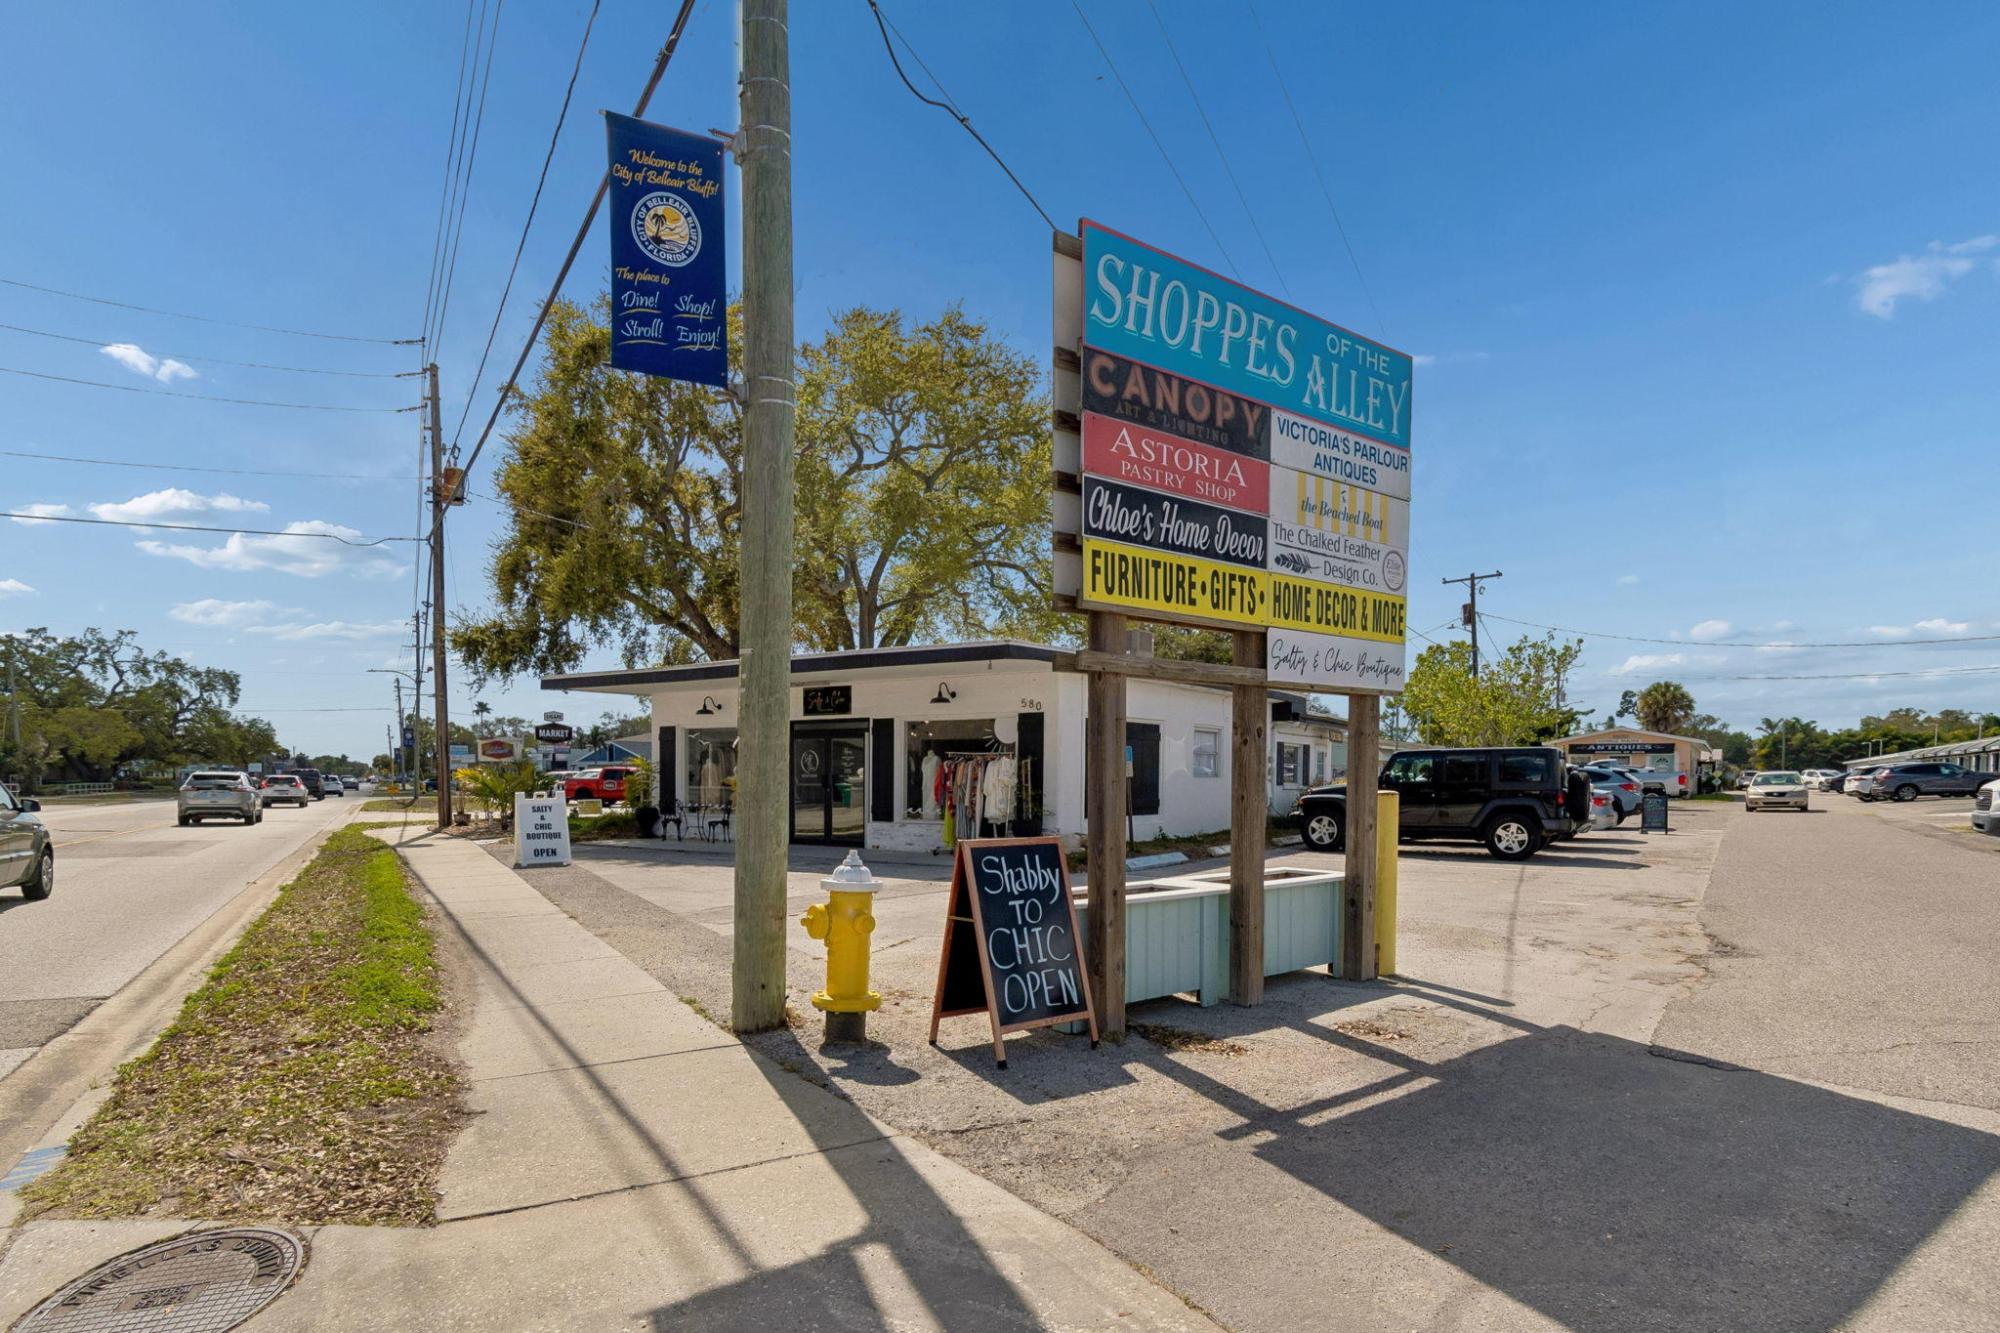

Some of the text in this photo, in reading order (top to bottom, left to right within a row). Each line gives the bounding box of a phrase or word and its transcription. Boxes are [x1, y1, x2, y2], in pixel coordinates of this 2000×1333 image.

[629, 149, 703, 176] Welcome to the
[612, 163, 719, 199] City of Belleair Bluffs!
[636, 196, 699, 253] CITY OF BELLEAIR BLUFFS
[647, 242, 689, 262] FLORIDA
[615, 266, 671, 287] The place to
[621, 290, 716, 323] Dine! Shop!
[1090, 252, 1299, 389] SHOPPES
[620, 318, 721, 352] Stroll! Enjoy!
[1325, 333, 1390, 377] OF THE
[1089, 354, 1264, 441] CANOPY
[1115, 401, 1142, 419] ART
[1301, 353, 1409, 436] ALLEY
[1109, 427, 1248, 488] ASTORIA
[1277, 416, 1409, 473] VICTORIA'S PARLOUR
[1120, 460, 1237, 502] PASTRY SHOP
[1313, 452, 1377, 485] ANTIQUES
[1088, 485, 1264, 562] Chloe's Home Decor
[1301, 497, 1318, 514] the
[1319, 500, 1361, 525] Beached
[1273, 522, 1382, 563] The Chalked Feather
[1091, 549, 1257, 615] FURNITURE GIFTS
[1323, 560, 1360, 585] Design
[1362, 568, 1379, 586] Co.
[1273, 580, 1404, 637] HOME DECOR & MORE
[1271, 638, 1402, 685] Salty & Chic Boutique
[1020, 697, 1042, 711] 580
[538, 728, 569, 738] MARKET
[531, 805, 552, 813] SALTY
[534, 823, 552, 831] CHIC
[526, 832, 561, 841] BOUTIQUE
[533, 848, 557, 858] OPEN
[981, 854, 1059, 904] Shabby
[1009, 899, 1042, 925] TO
[989, 925, 1071, 969] CHIC
[1004, 968, 1078, 1013] OPEN
